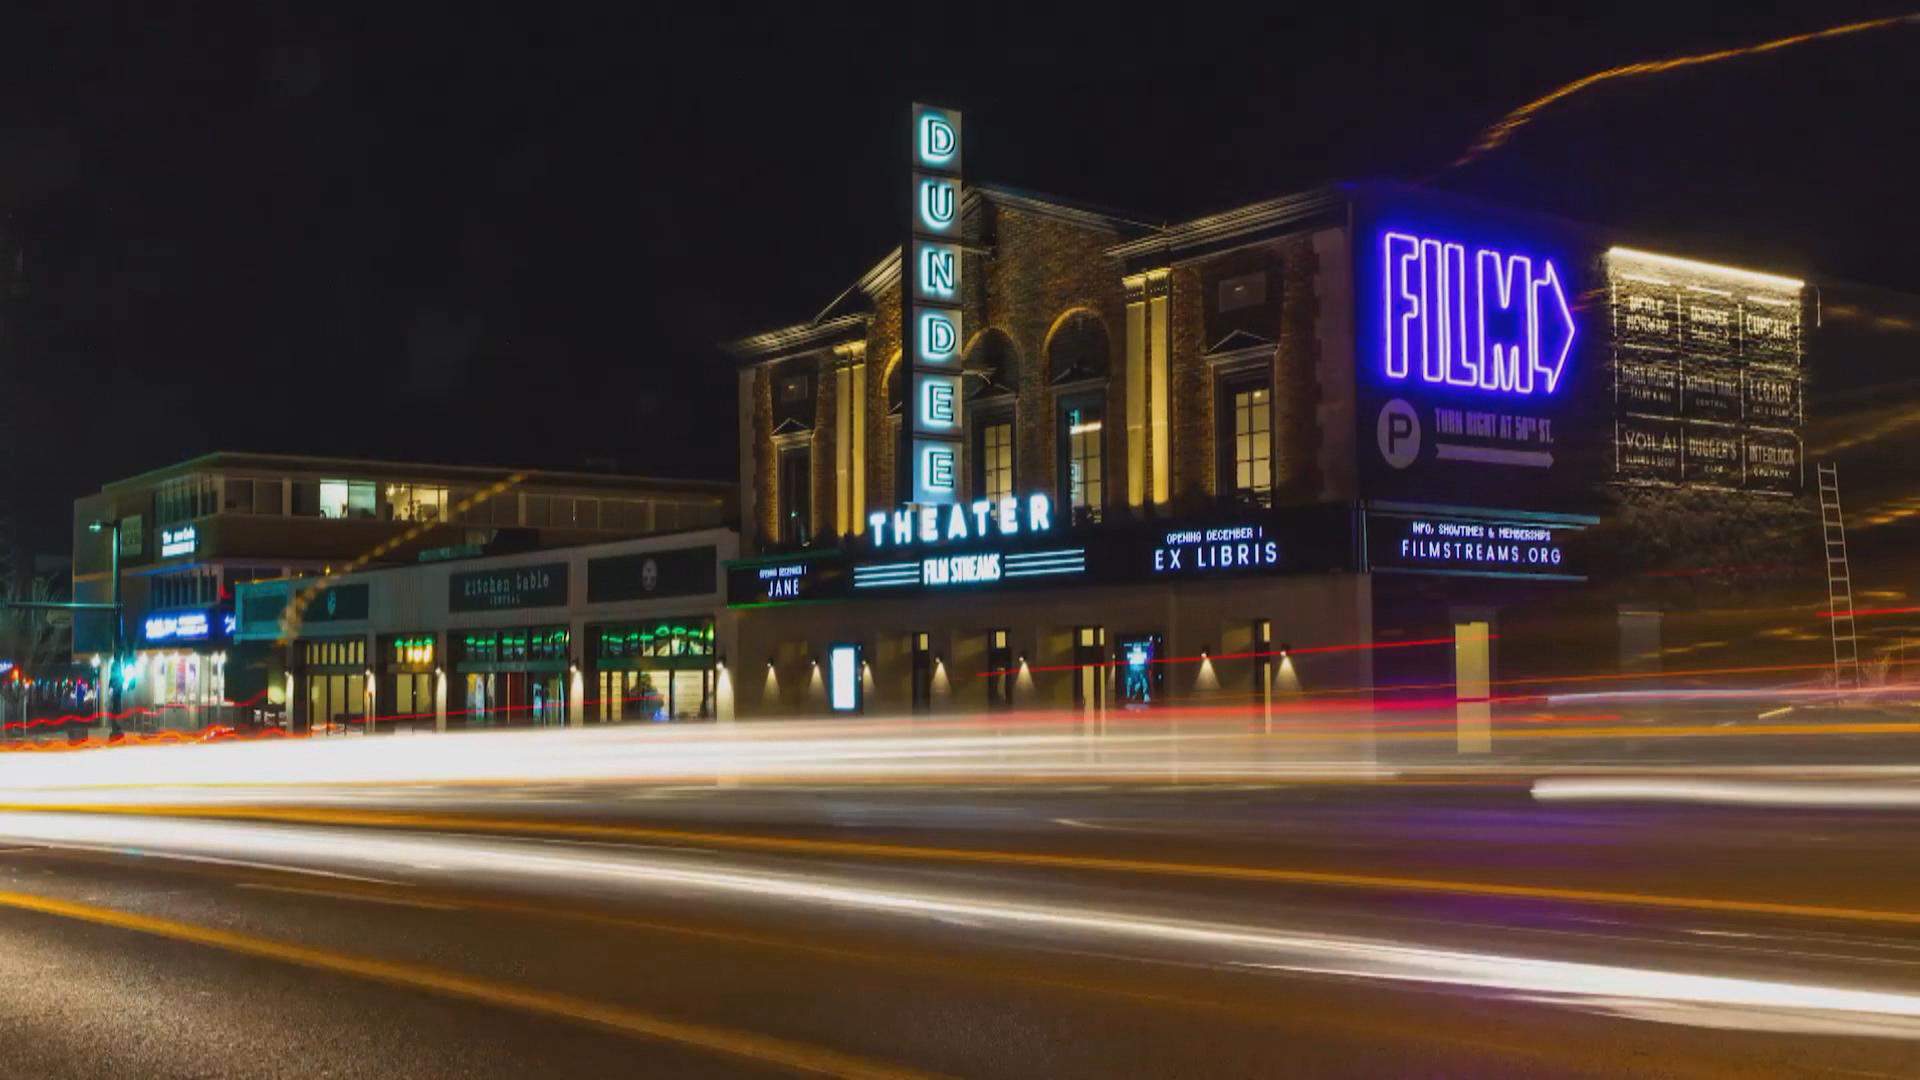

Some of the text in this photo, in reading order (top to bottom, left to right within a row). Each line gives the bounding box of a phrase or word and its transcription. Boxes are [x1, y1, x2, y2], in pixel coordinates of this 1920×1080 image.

[922, 116, 956, 492] DUNDEE
[1385, 232, 1533, 393] FILM
[1750, 379, 1792, 403] LEGACY
[1389, 412, 1413, 454] P
[1435, 407, 1463, 435] TURN
[1500, 415, 1512, 440] AT
[1689, 437, 1737, 461] DUGGER'S
[1749, 445, 1796, 466] INTERLOCK
[869, 493, 1051, 547] THEATER
[1438, 523, 1484, 537] SHOWTIMES
[1166, 531, 1202, 544] OPENING
[1206, 527, 1253, 541] DECEMBER
[1155, 542, 1277, 570] EX LIBRIS
[1402, 540, 1561, 564] FILMSTREAMS.ORG
[923, 553, 1001, 585] FILM STREAMS
[464, 570, 551, 596] kitchen table
[768, 578, 799, 597] JANE
